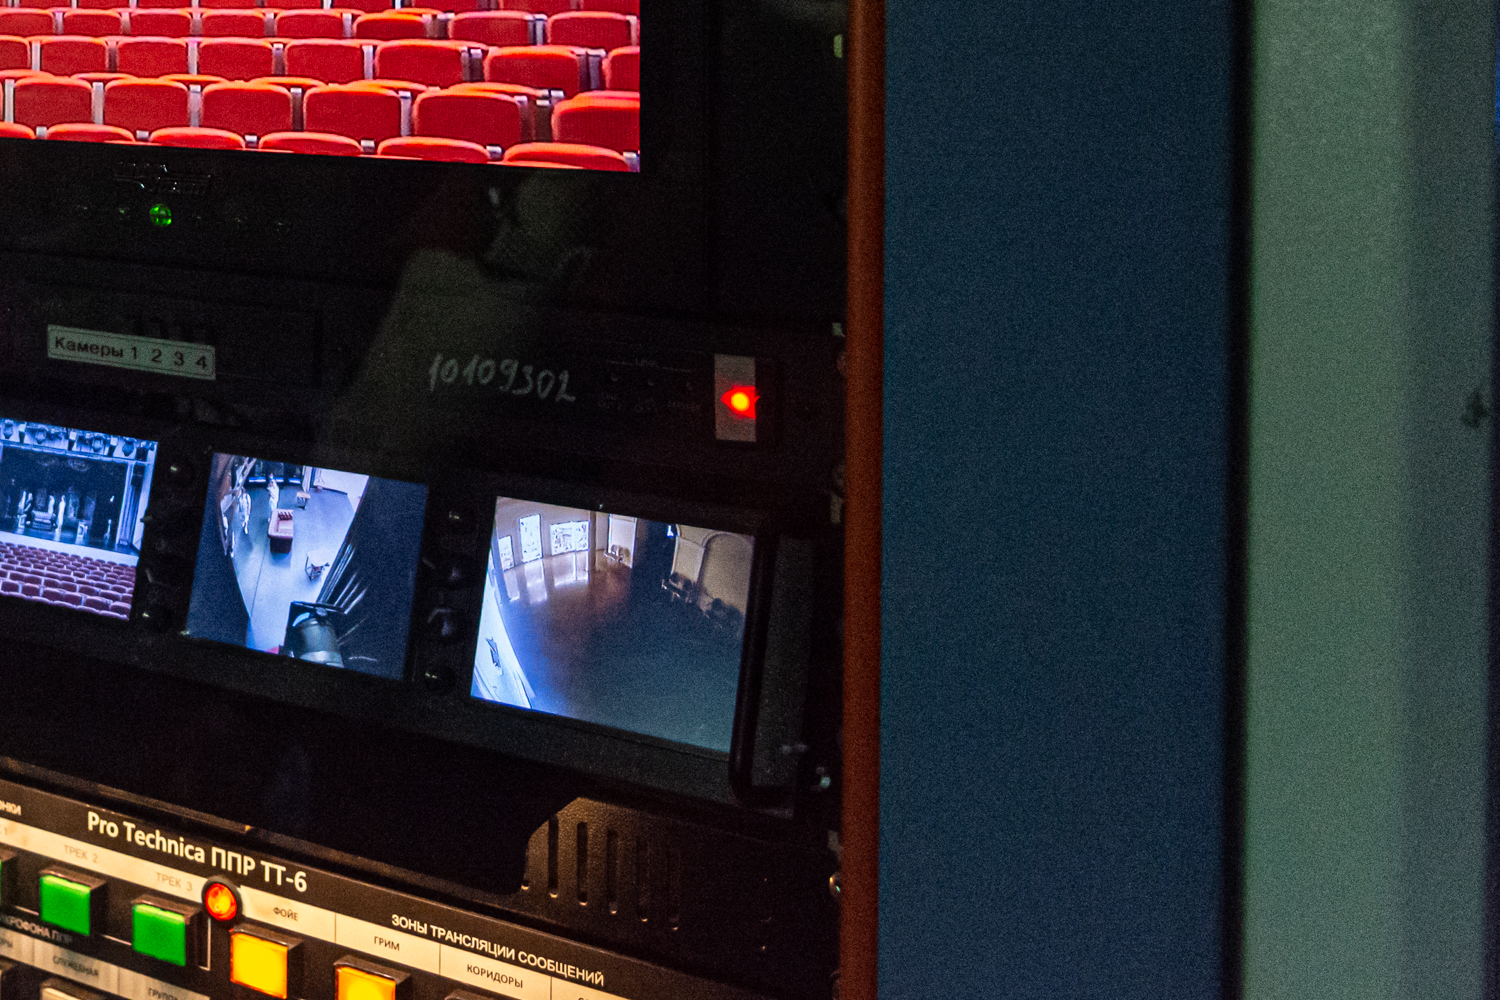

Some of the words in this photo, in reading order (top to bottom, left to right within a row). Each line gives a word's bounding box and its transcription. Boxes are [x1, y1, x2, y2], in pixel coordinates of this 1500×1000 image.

[55, 335, 123, 358] Камеры
[131, 346, 138, 360] 1
[151, 349, 162, 364] 2
[173, 352, 185, 366] 3
[196, 355, 207, 369] 4
[428, 352, 576, 402] 10109302
[64, 844, 88, 862] ТРЕК
[87, 811, 119, 837] Pro
[123, 820, 206, 864] Technica
[211, 846, 256, 876] ППР
[156, 872, 182, 890] ТРЕК
[186, 881, 193, 892] 3
[273, 904, 299, 922] ФОЙЕ
[373, 936, 400, 951] ГРИМ
[391, 913, 429, 935] ЗОНЫ
[430, 924, 516, 961] ТРАНСЛЯЦИИ
[517, 950, 605, 987] СООБЩЕНИЙ
[466, 963, 524, 990] КОРИДОРЫ
